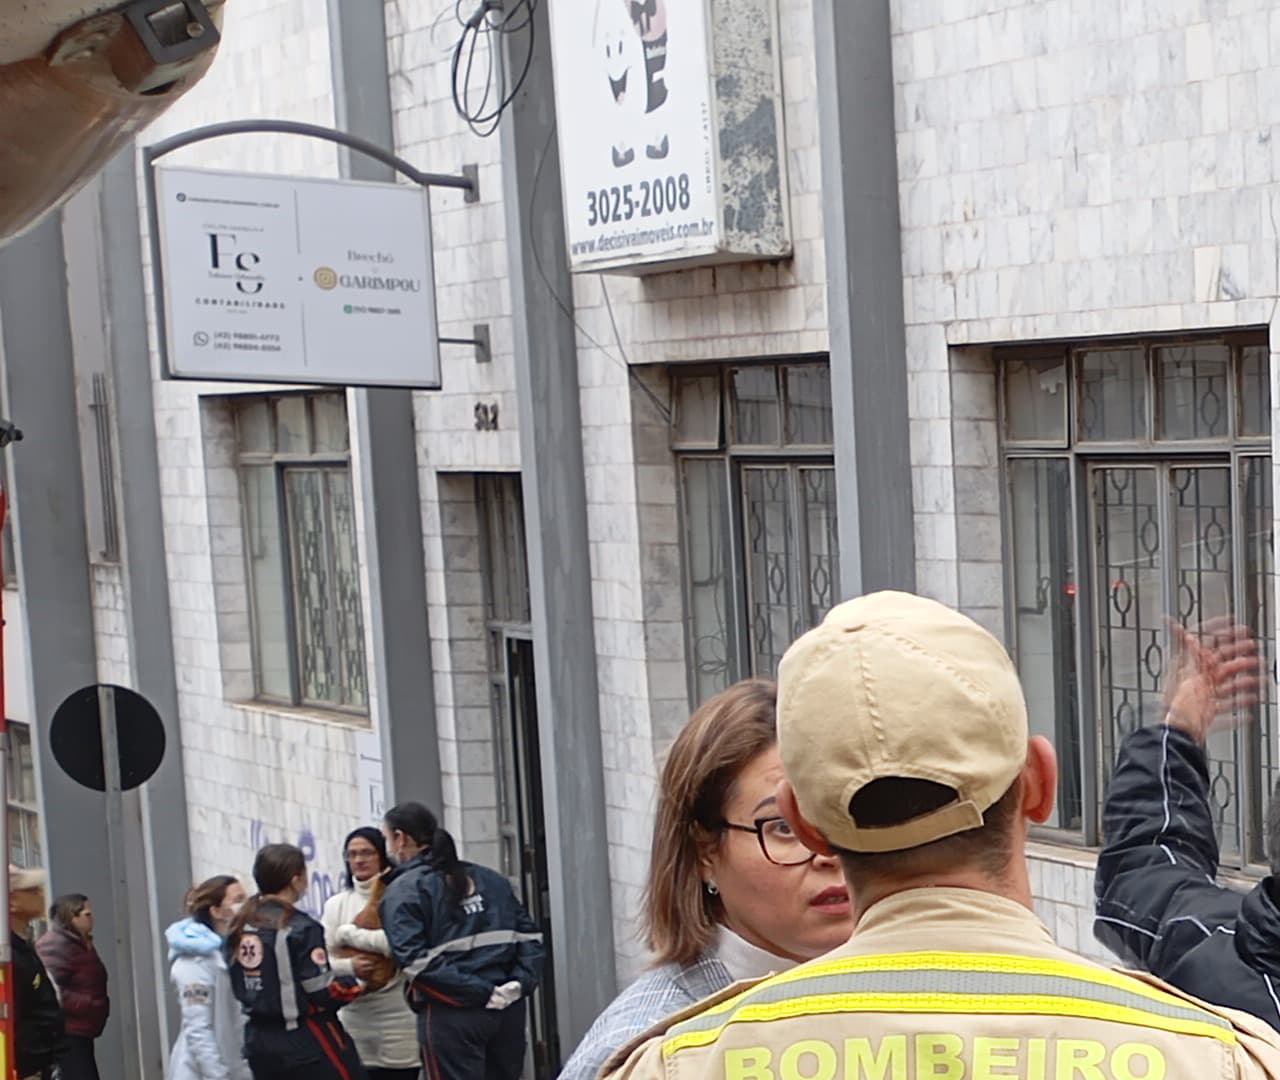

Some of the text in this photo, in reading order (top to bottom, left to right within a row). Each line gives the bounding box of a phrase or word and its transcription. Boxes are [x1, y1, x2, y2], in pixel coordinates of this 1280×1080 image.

[587, 173, 691, 227] 3025-2008
[571, 217, 714, 256] www.decisivaimoveis.com.br
[339, 274, 421, 293] GARIMPOU
